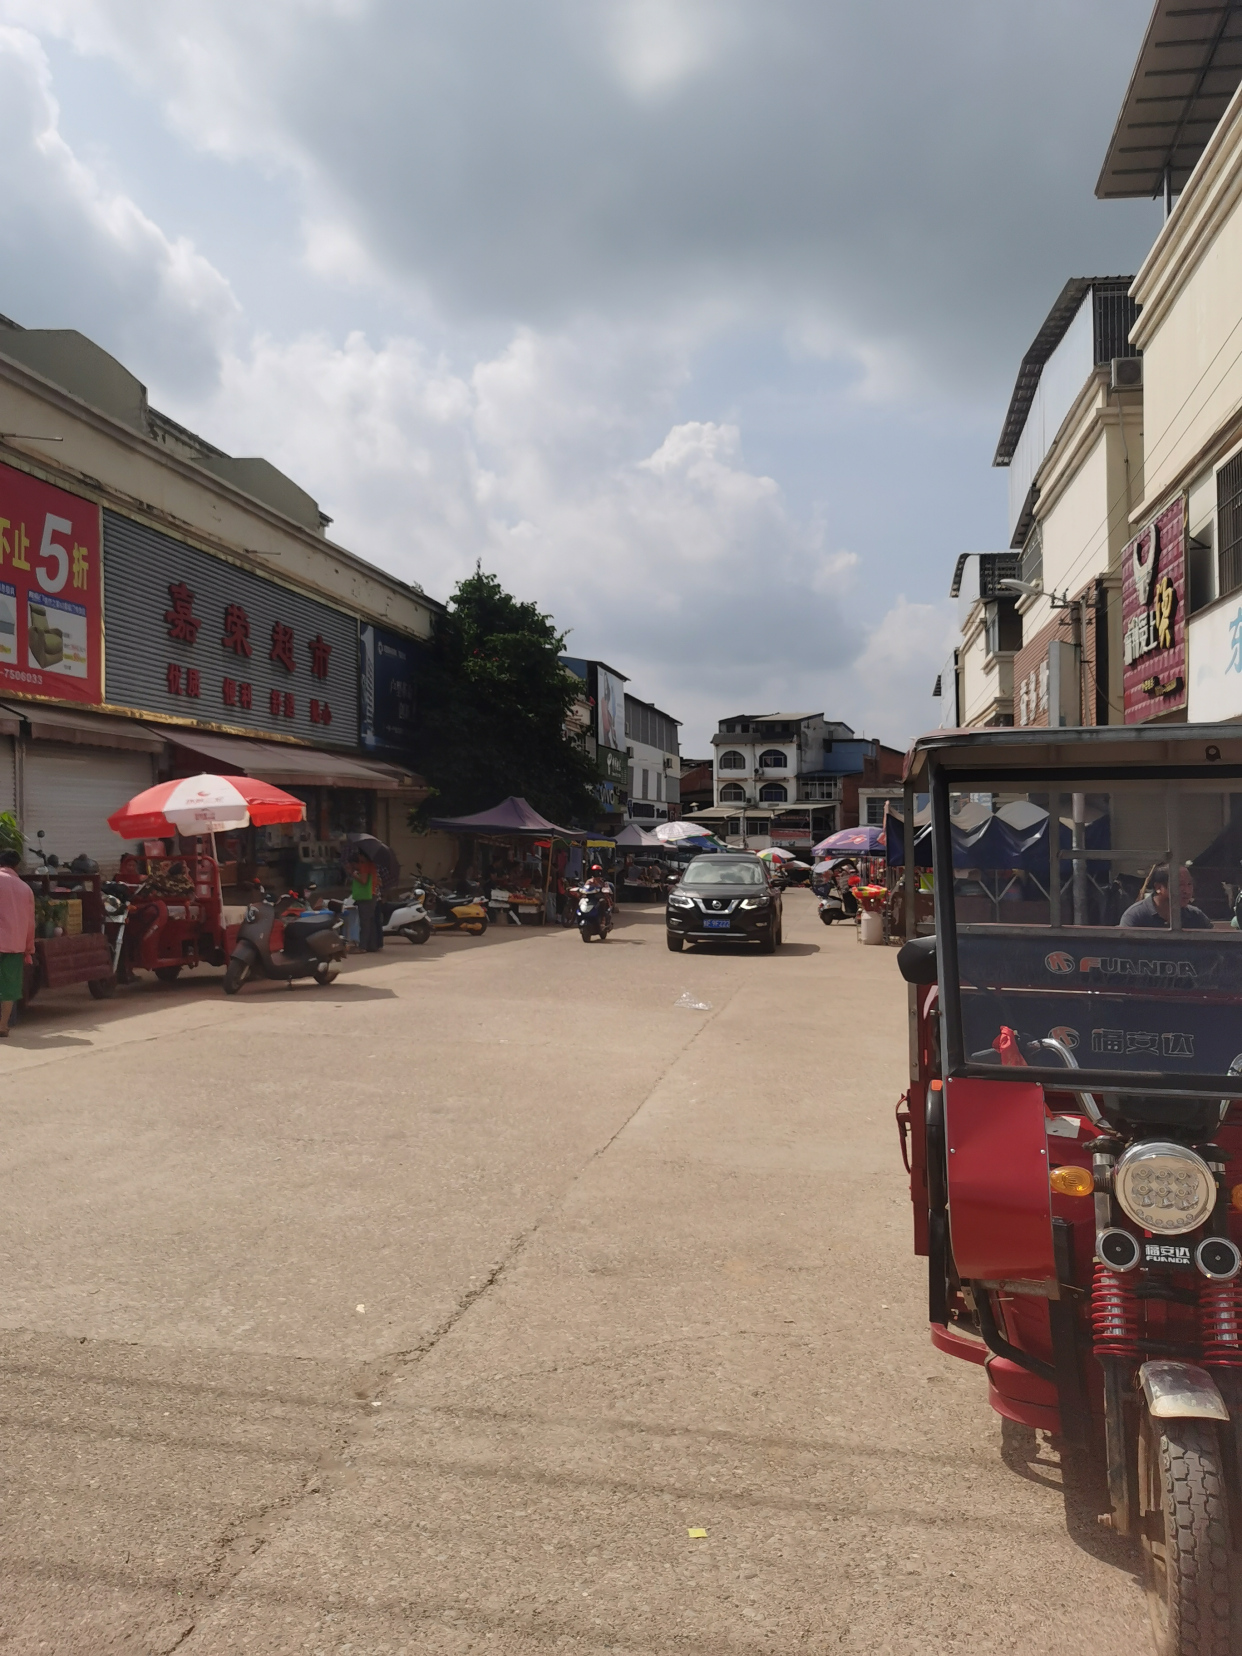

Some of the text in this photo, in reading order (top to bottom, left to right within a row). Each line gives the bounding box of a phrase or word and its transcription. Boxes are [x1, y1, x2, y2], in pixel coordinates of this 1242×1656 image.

[164, 582, 332, 679] 嘉荣超市
[167, 663, 200, 697] 优质
[1079, 957, 1198, 977] FUANDA
[1092, 1028, 1195, 1057] 福安达
[1145, 1244, 1190, 1258] 福安达
[1146, 1255, 1190, 1264] FUANDA
